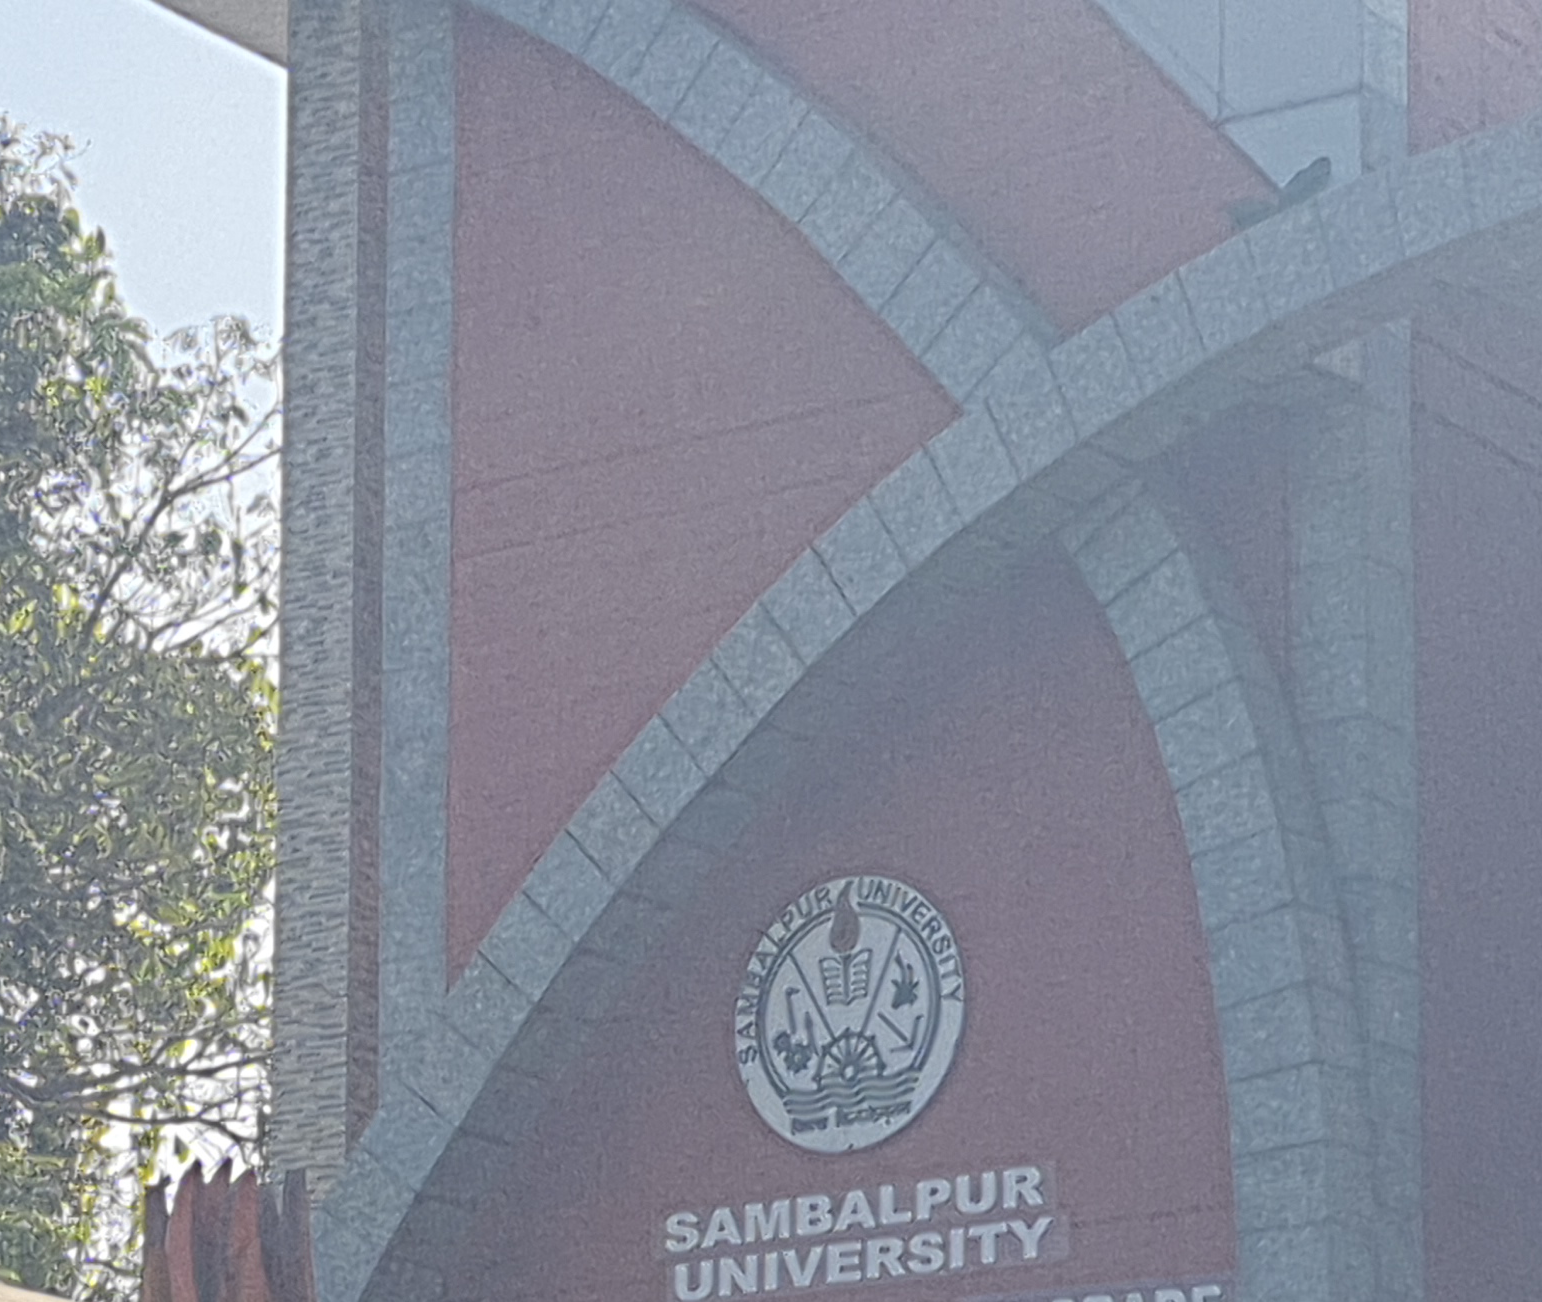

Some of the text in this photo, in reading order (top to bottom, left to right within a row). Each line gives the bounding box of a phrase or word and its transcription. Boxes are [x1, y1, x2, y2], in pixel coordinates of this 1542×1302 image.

[858, 876, 964, 1003] UNIVERSITY
[663, 1165, 1046, 1254] SAMBALPUR
[673, 1216, 1054, 1302] UNIVERSITY
